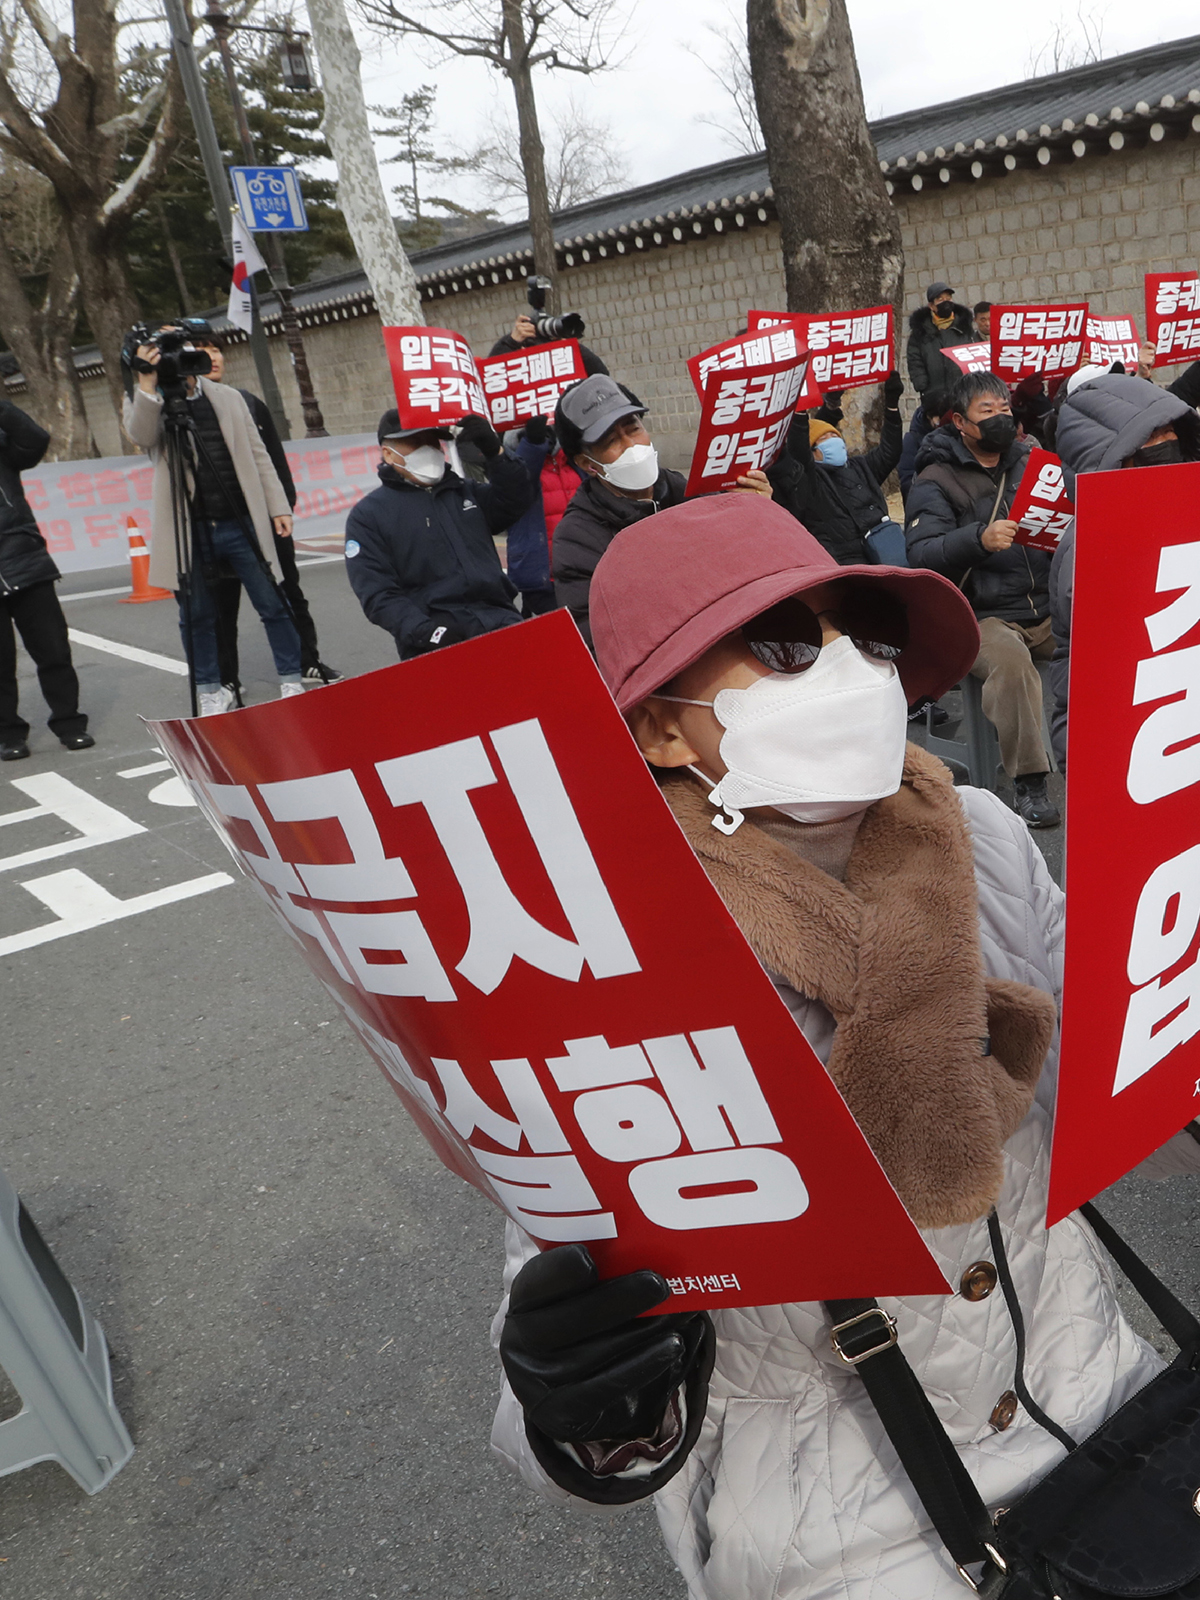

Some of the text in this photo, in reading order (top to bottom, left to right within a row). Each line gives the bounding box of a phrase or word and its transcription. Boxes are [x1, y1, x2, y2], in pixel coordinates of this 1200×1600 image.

[807, 312, 888, 351] 중국폐렴
[998, 309, 1084, 341] 입국금지
[483, 346, 575, 394] 중국폐렴
[812, 345, 890, 383] 입국금지
[952, 343, 991, 362] 중국
[998, 341, 1082, 373] 즉각실행
[491, 378, 581, 424] 입국금
[665, 1273, 741, 1295] 법치센터
